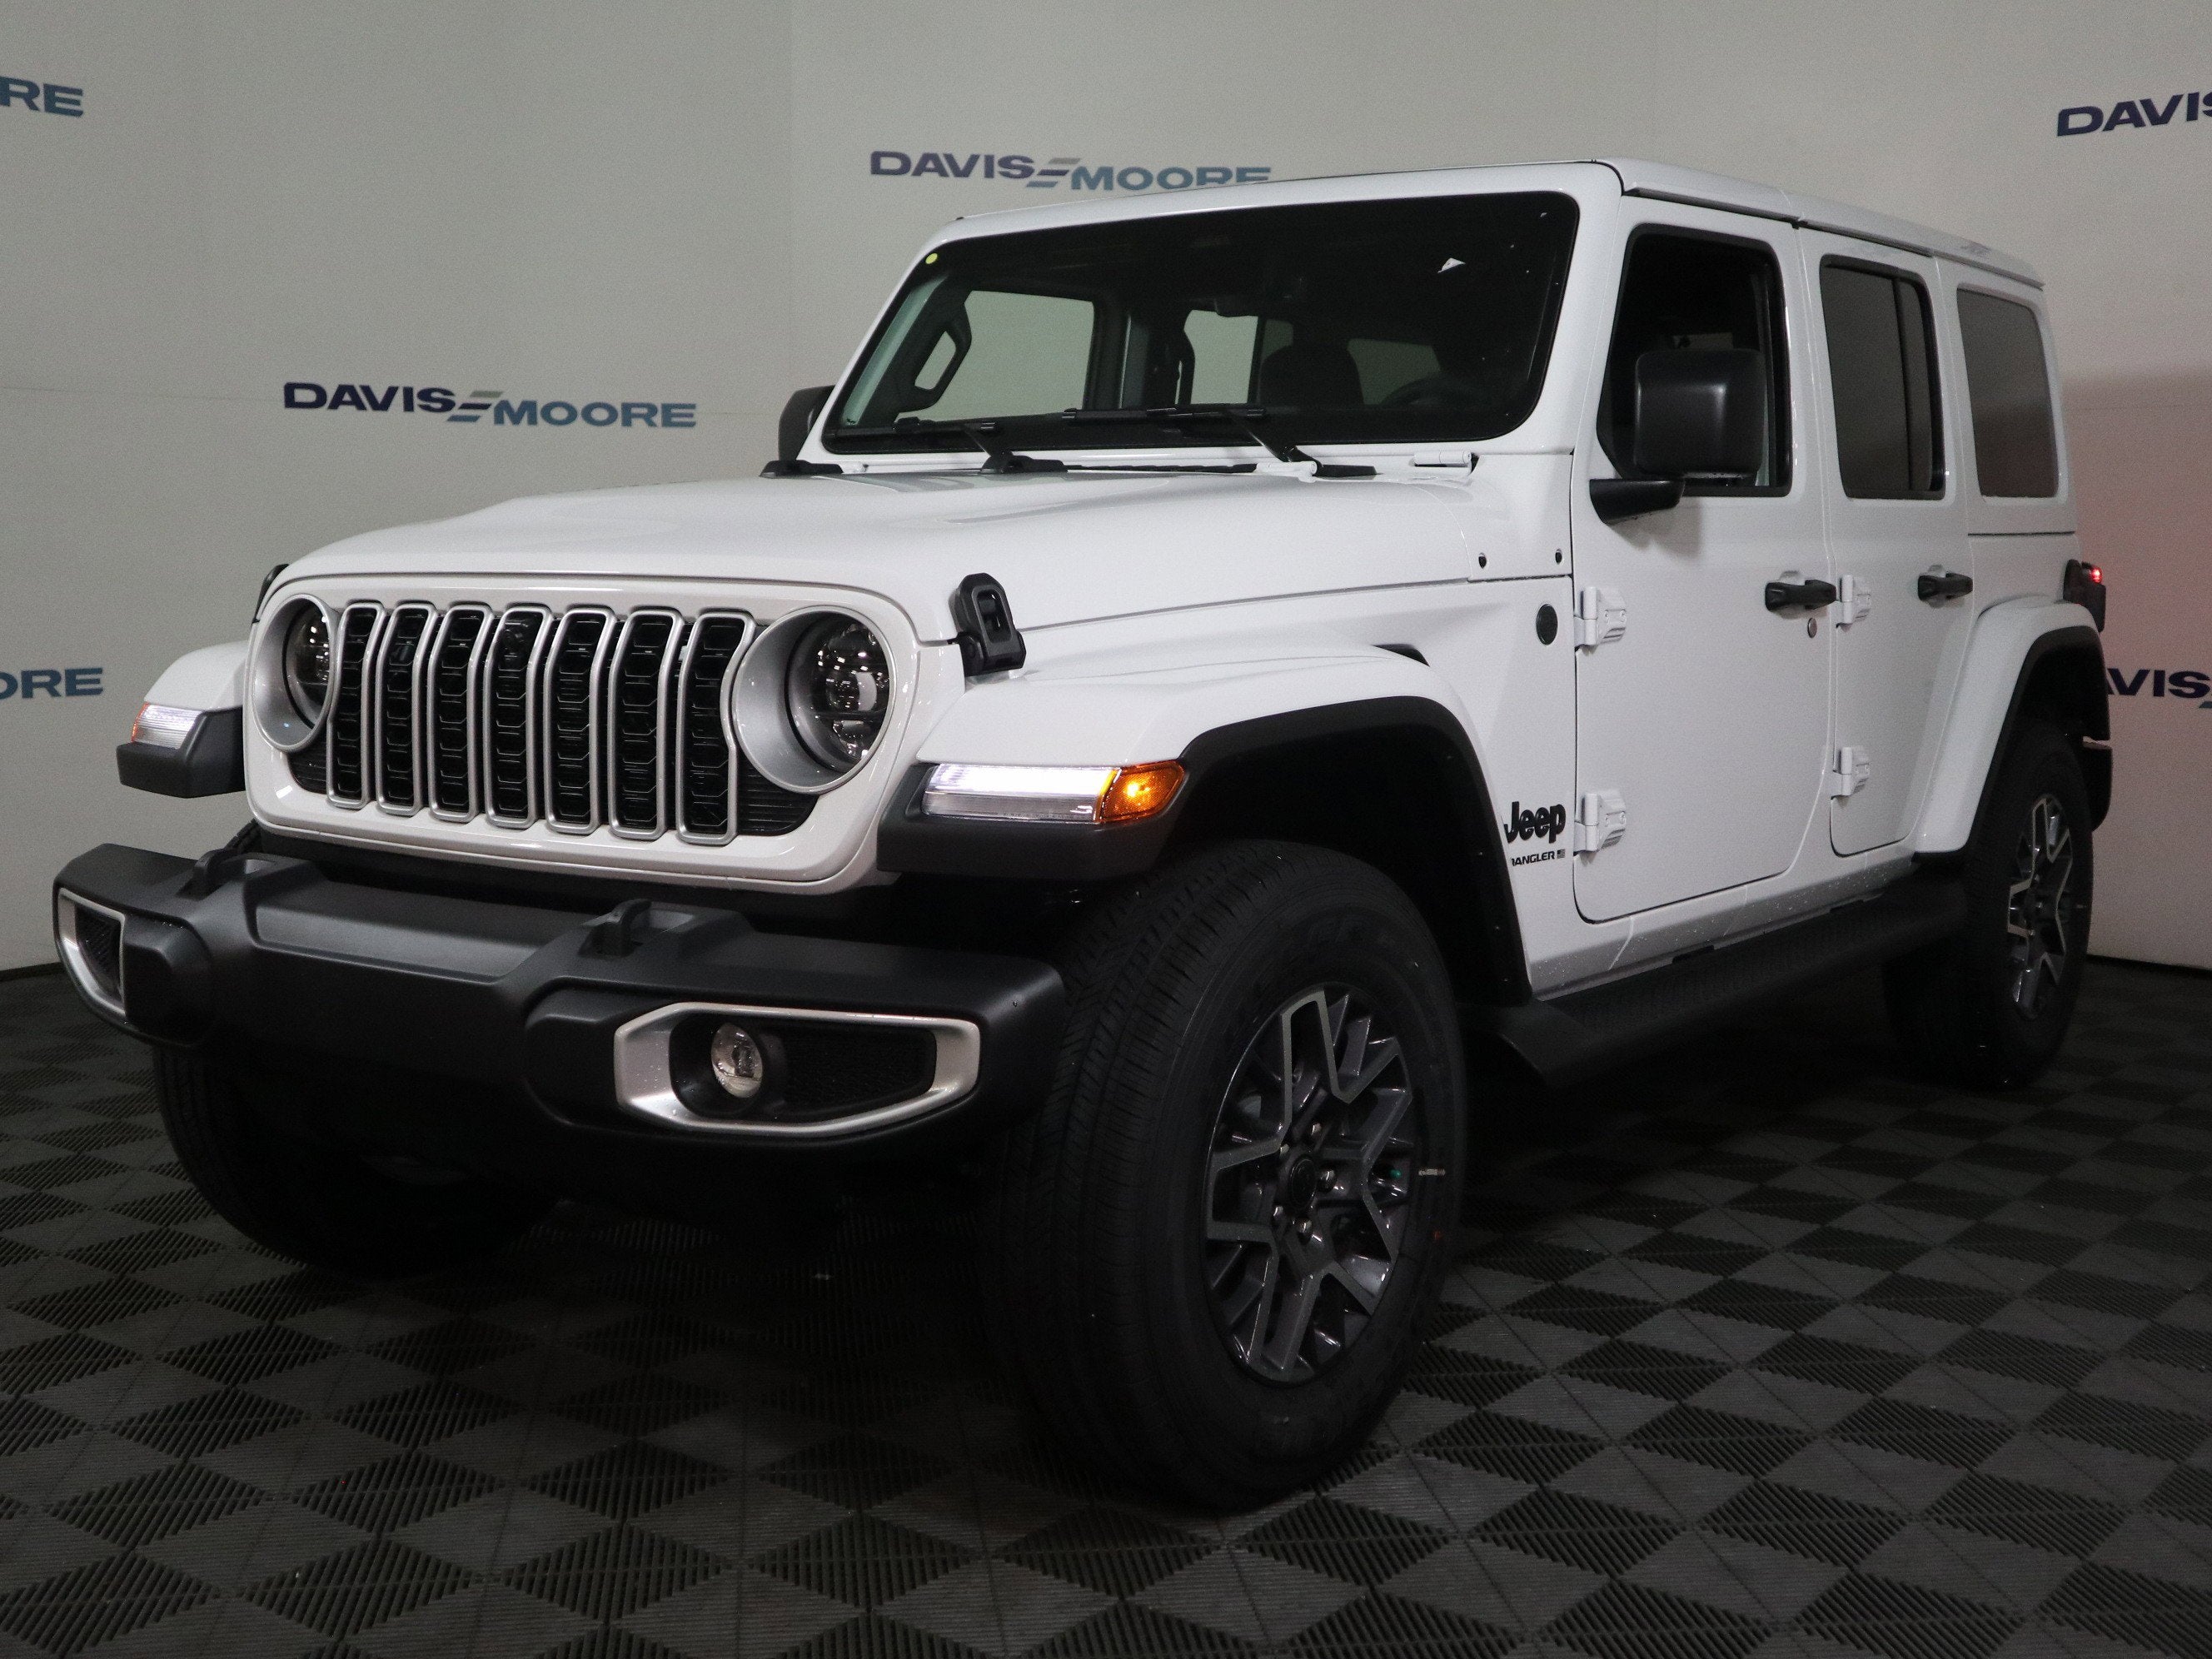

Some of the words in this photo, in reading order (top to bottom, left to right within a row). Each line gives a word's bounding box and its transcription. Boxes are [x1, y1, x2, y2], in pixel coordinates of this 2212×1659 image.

[2057, 92, 2212, 137] DAVI
[870, 150, 1035, 179] DAVIS
[1071, 166, 1271, 191] MOORE
[283, 381, 456, 413] DAVIS
[494, 400, 697, 428] MOORE
[2106, 668, 2211, 699] VIS
[1503, 800, 1566, 844] Jeep
